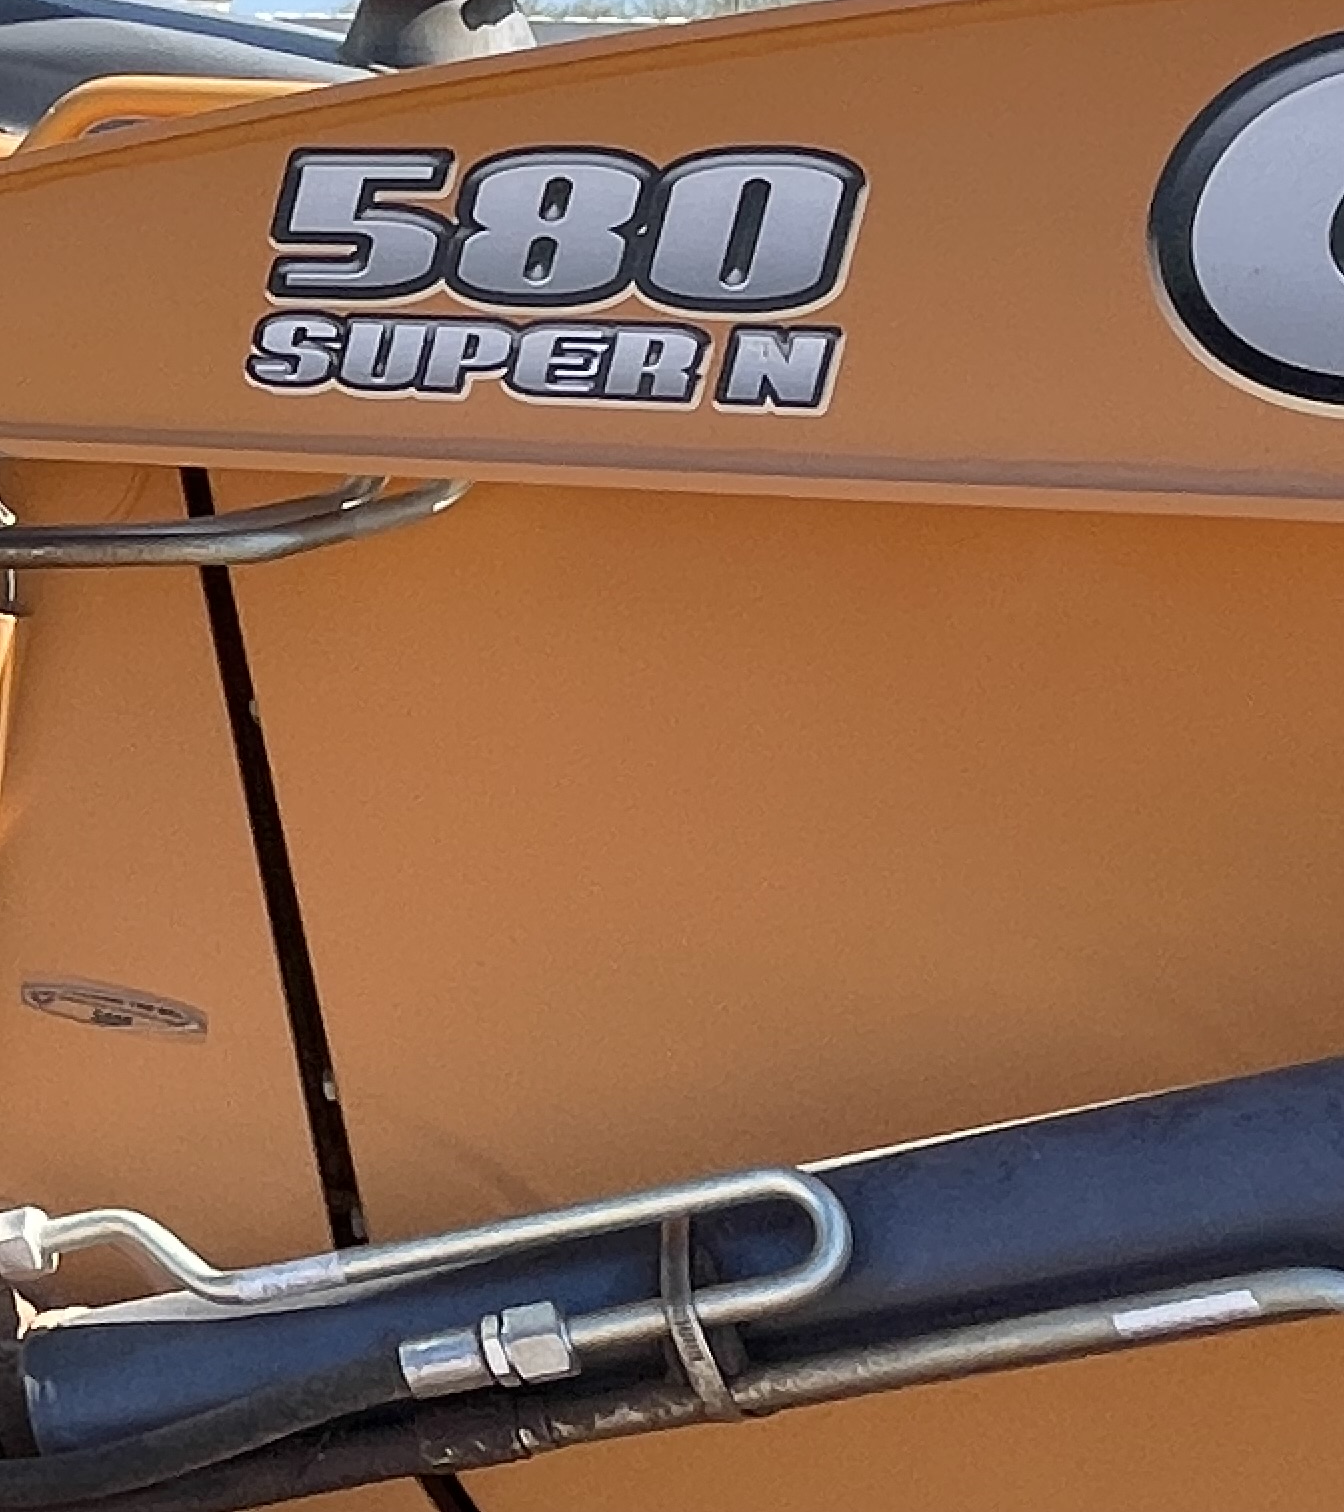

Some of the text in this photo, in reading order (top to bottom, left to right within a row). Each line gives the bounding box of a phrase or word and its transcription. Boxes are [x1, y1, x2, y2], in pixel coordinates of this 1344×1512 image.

[267, 146, 866, 313] 580
[246, 311, 844, 412] SUPER N
